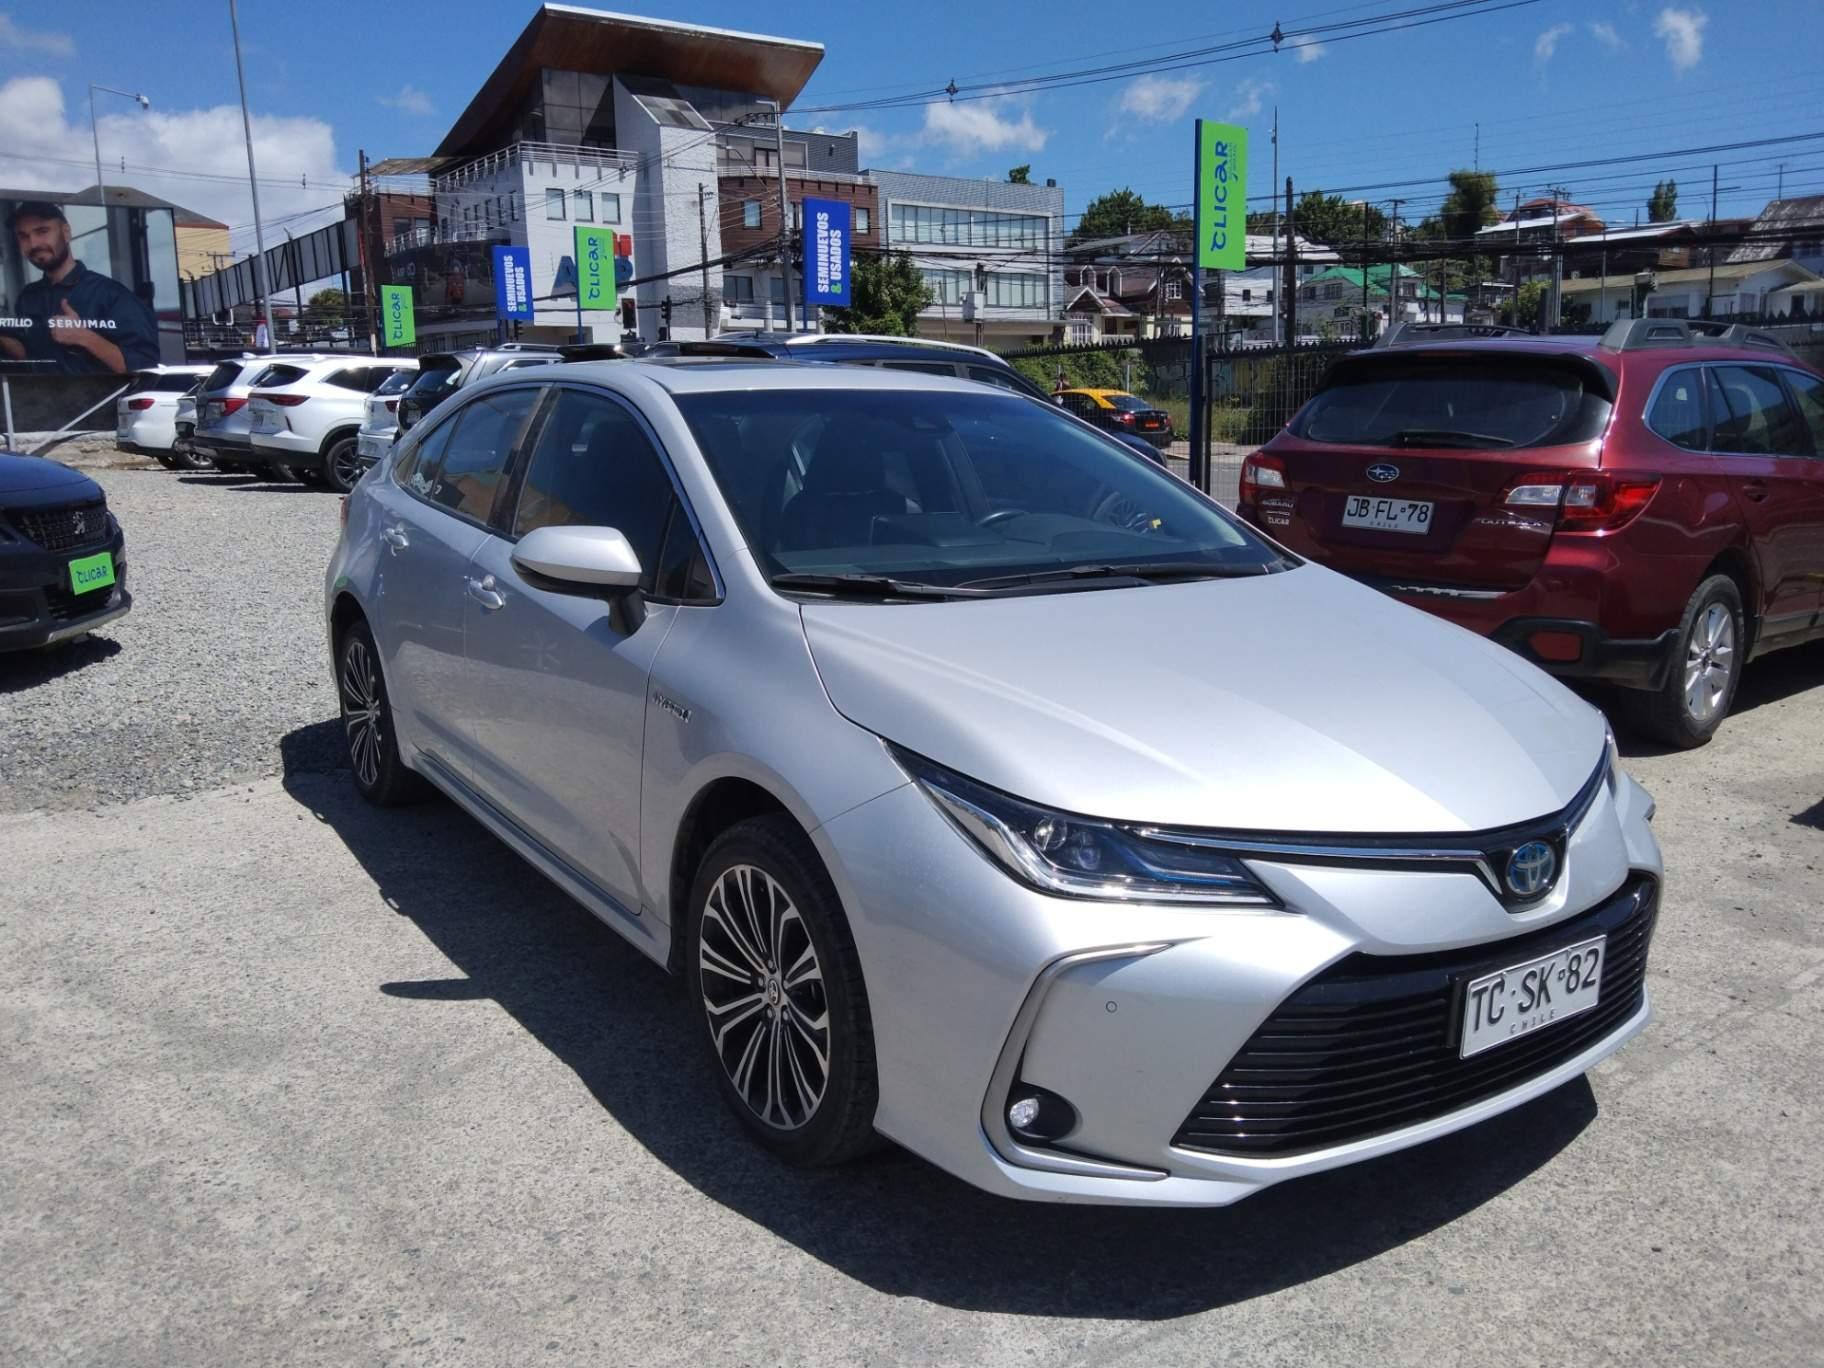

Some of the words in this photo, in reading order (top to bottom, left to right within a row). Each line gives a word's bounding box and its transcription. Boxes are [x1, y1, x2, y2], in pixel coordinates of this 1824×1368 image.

[817, 212, 829, 293] SEMINUEVOS
[830, 230, 842, 281] USADOS
[504, 255, 517, 312] SEMINUEVOS
[515, 266, 526, 303] USADOS
[831, 282, 842, 294] &
[48, 319, 117, 329] SERVIMAQ
[1510, 1010, 1555, 1034] CHILE
